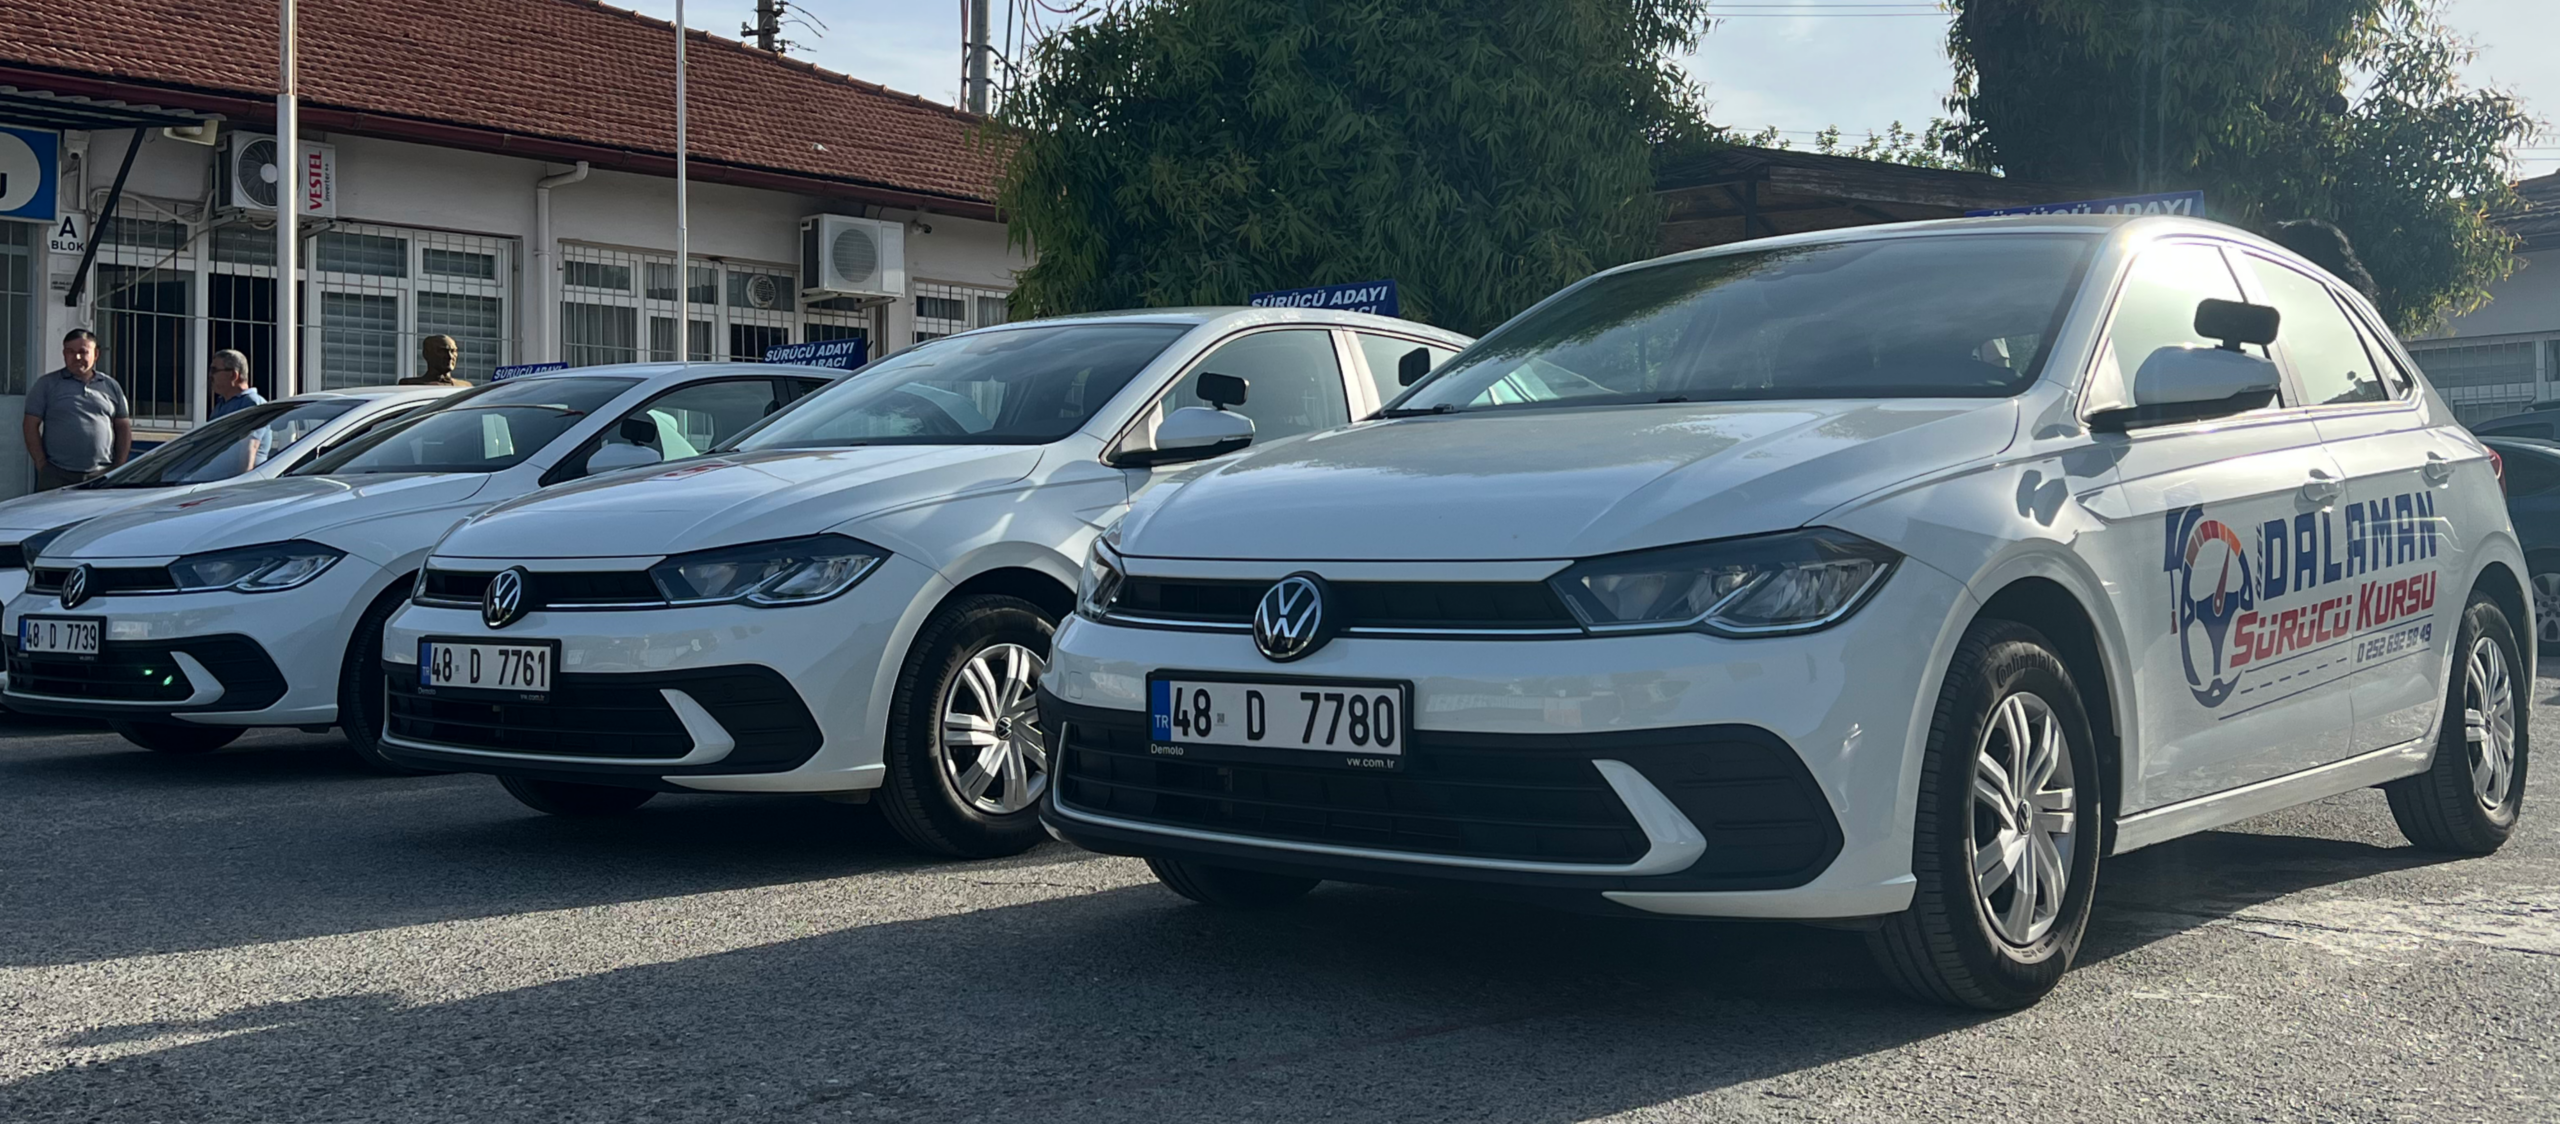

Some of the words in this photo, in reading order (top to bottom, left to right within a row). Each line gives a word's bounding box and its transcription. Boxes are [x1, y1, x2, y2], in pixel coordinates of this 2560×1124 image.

[309, 150, 323, 210] VESTEL
[58, 216, 78, 238] A
[51, 239, 85, 251] BLOK
[1251, 289, 1326, 308] SÜRÜCÜ
[1329, 286, 1388, 306] ADAYI
[765, 344, 815, 362] SÜRÜCÜ
[816, 342, 855, 357] ADAYI
[2264, 491, 2437, 600] DALAMAN
[2230, 594, 2353, 668] SÜRÜCÜ
[2356, 571, 2437, 631] KURSU
[26, 622, 40, 648] 48
[49, 623, 57, 649] D
[67, 624, 97, 651] 7739
[2357, 643, 2365, 663] 0
[2366, 637, 2386, 660] 252
[2386, 631, 2406, 654] 692
[2420, 623, 2432, 643] 49
[432, 647, 453, 682] 48
[470, 648, 481, 684] D
[498, 649, 546, 687] 7761
[1154, 714, 1169, 729] TR
[1173, 687, 1212, 738] 48
[1246, 690, 1266, 741] D
[1300, 692, 1396, 747] 7780
[1346, 757, 1396, 769] vw.com.tr
